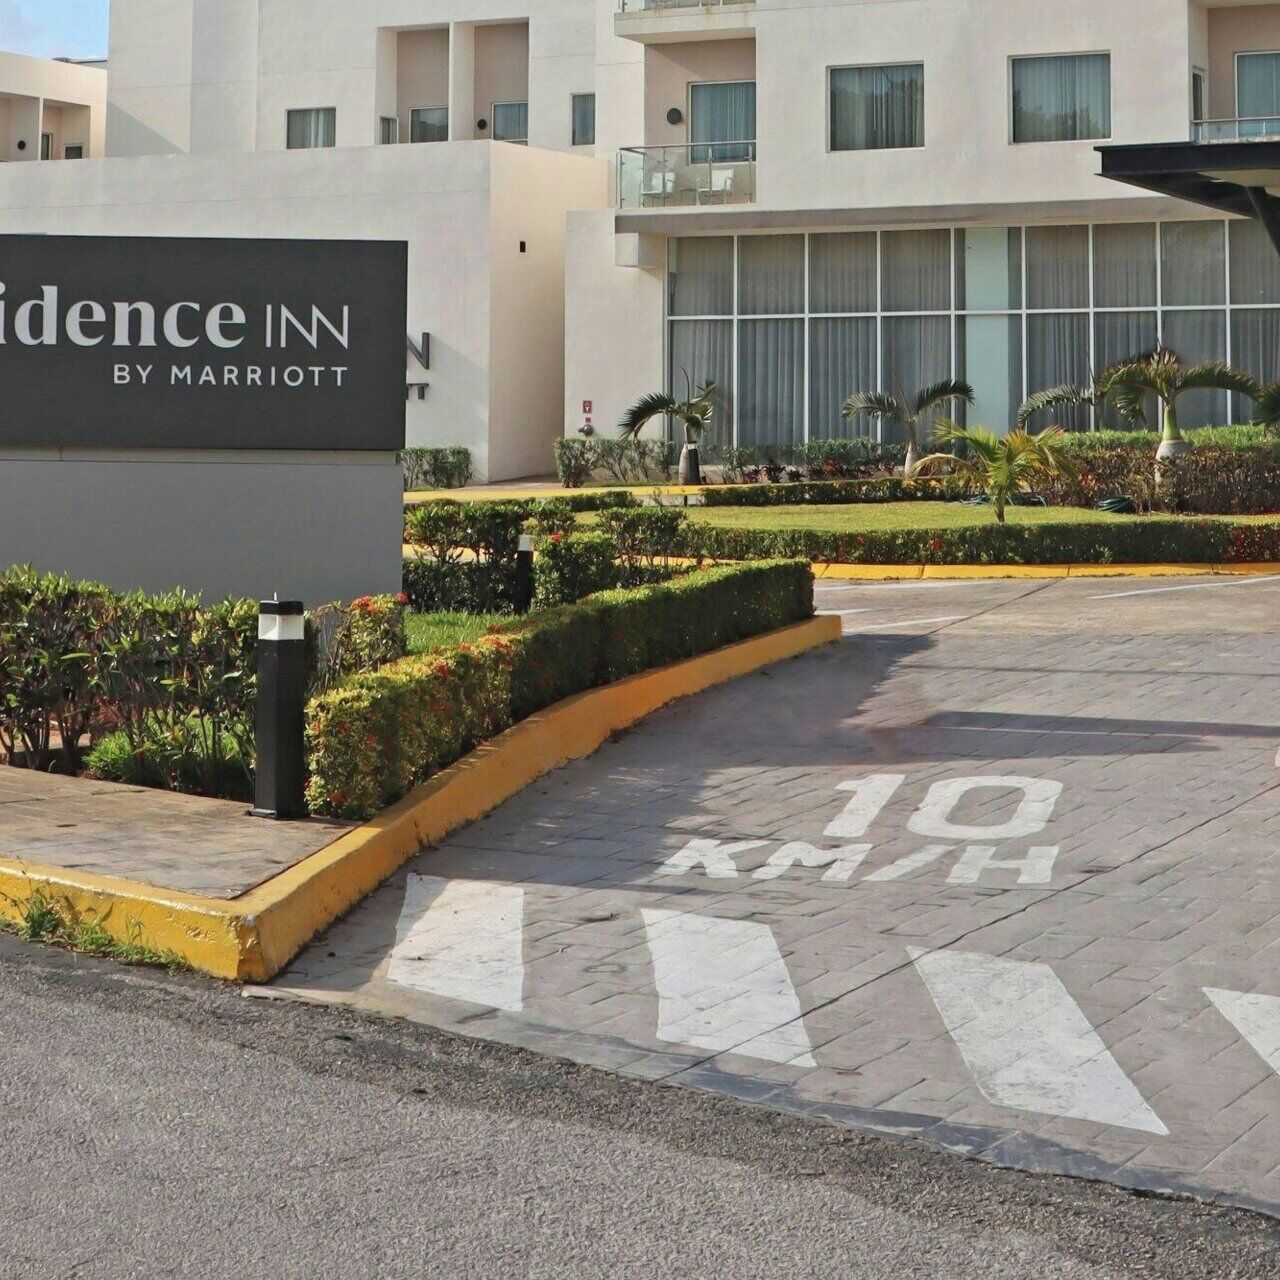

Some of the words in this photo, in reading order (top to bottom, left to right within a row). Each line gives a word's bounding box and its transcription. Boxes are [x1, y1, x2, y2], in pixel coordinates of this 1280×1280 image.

[265, 303, 350, 350] INN
[113, 363, 153, 385] BY
[170, 364, 349, 388] MARRIOTT
[822, 773, 1064, 839] 10
[654, 838, 1060, 884] KM/H
